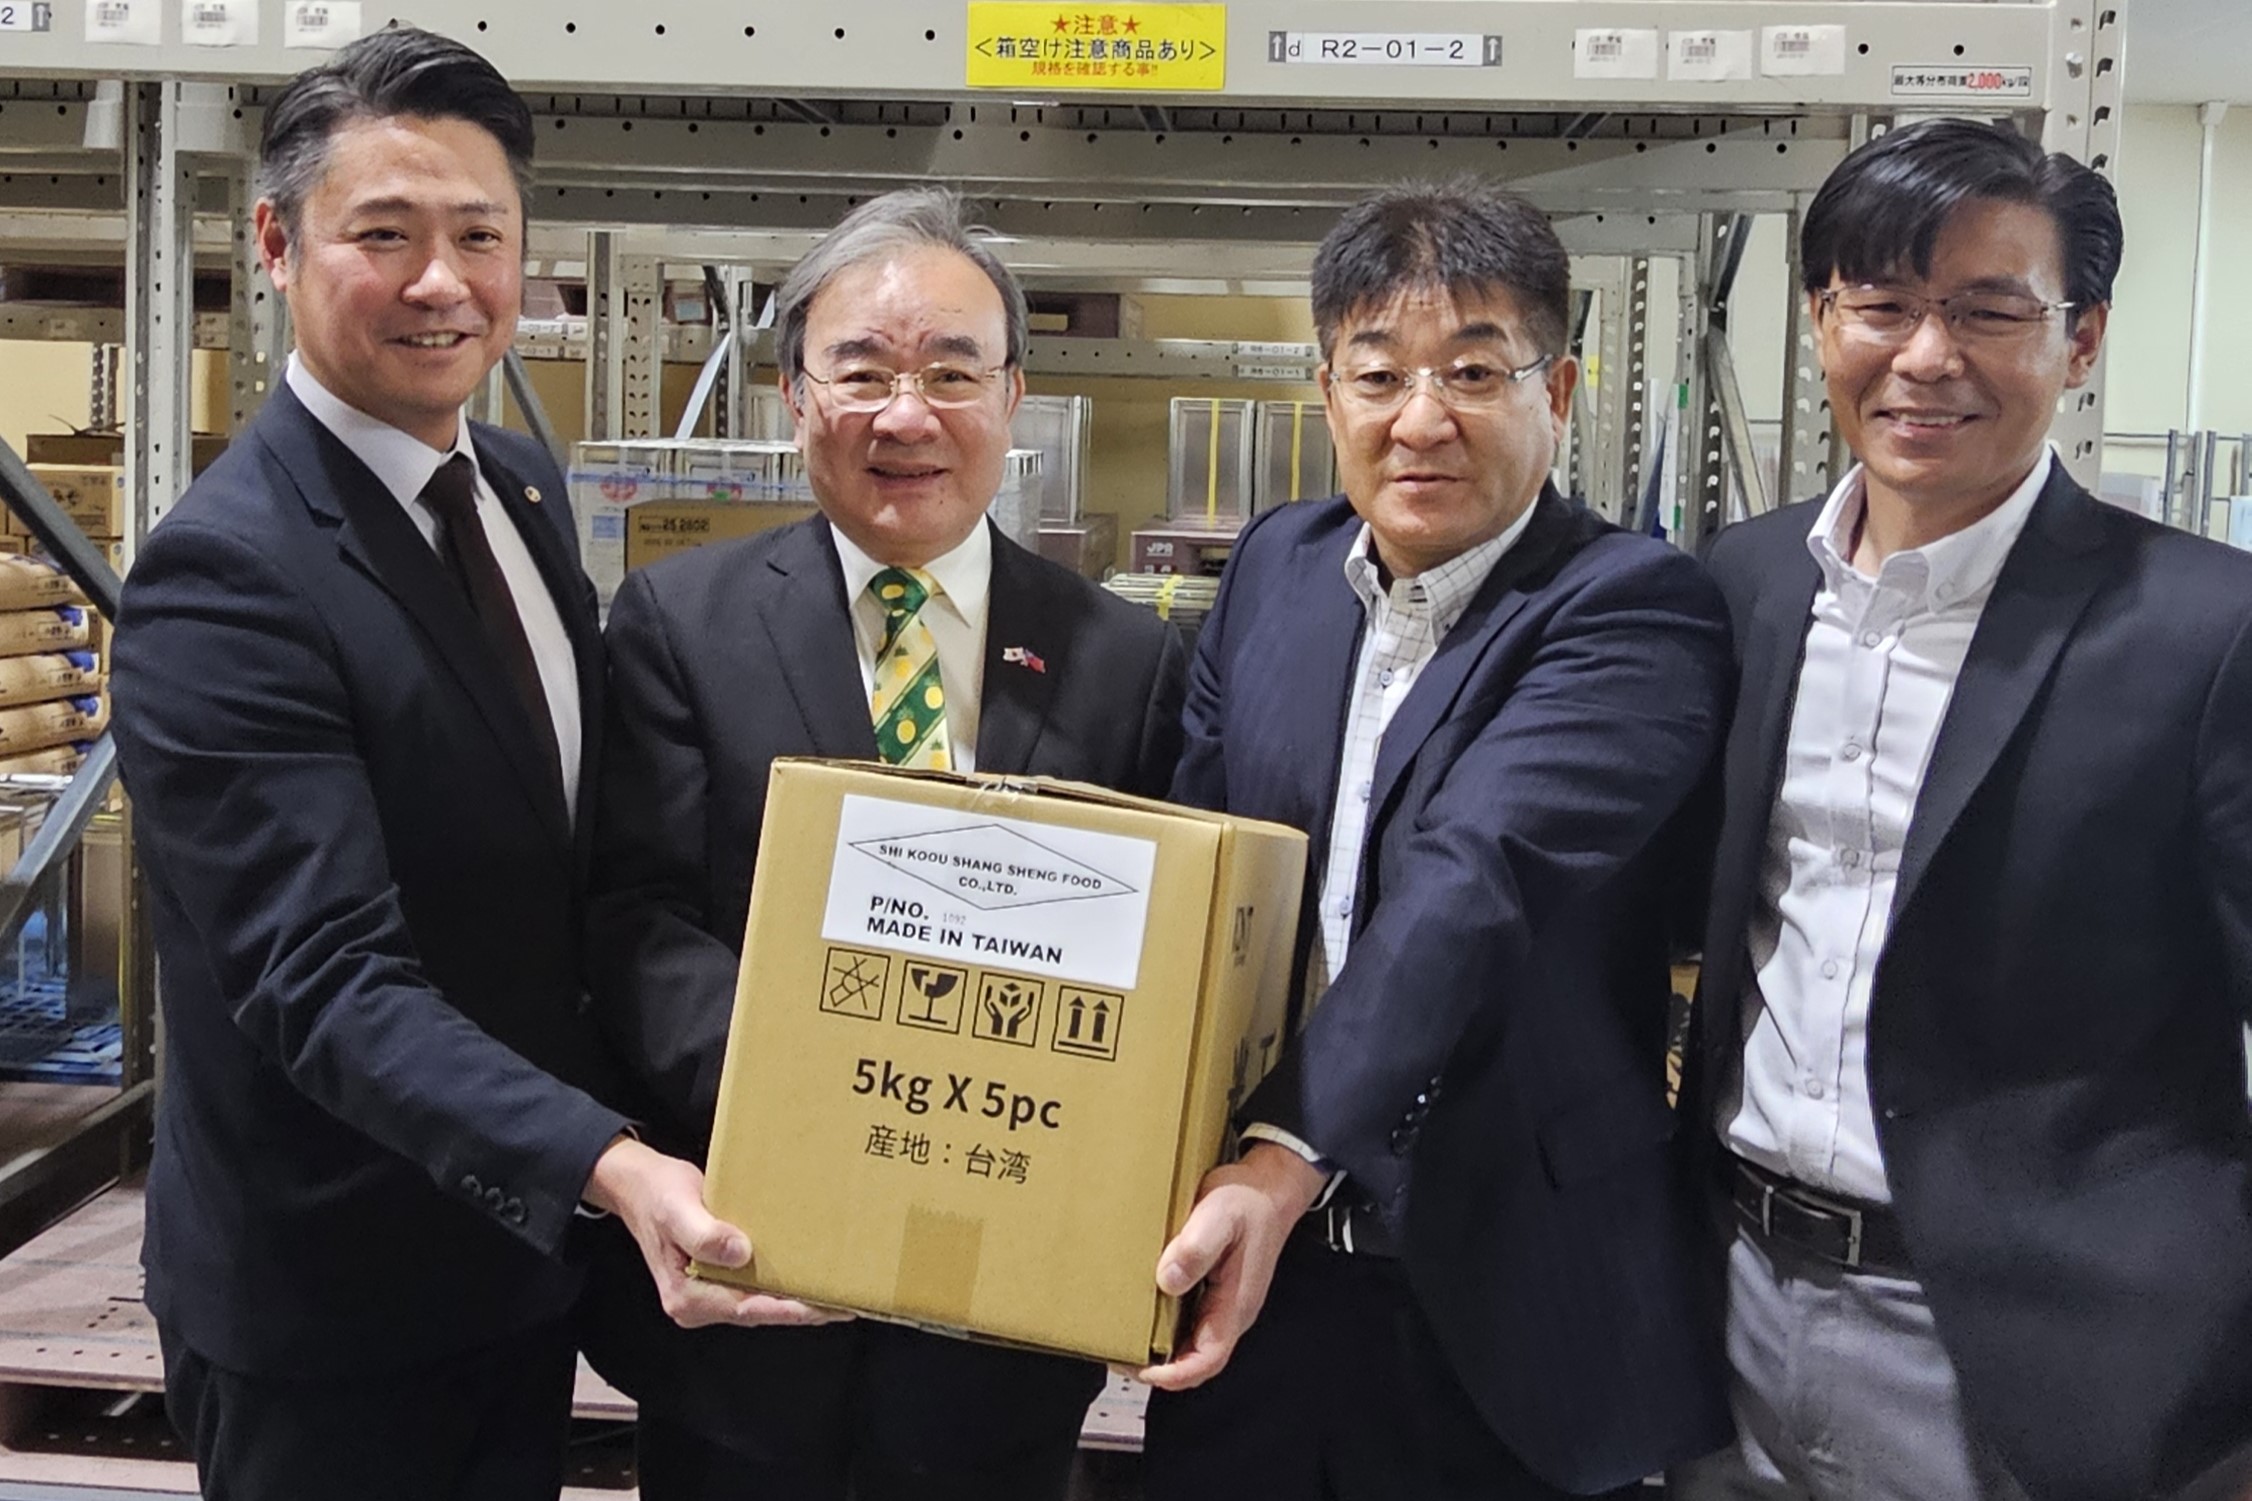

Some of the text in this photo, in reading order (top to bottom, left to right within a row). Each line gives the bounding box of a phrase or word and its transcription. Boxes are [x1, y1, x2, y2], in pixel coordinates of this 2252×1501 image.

[1321, 39, 1464, 59] R2-01-2
[879, 844, 1102, 890] SHI KOOU SHANG SHENG FOOD
[958, 876, 1018, 896] CO.,LTD.
[869, 896, 930, 920] P/NO.
[866, 917, 1063, 964] MADE IN TAIWAN
[852, 1058, 1062, 1131] 5kg X 5pc
